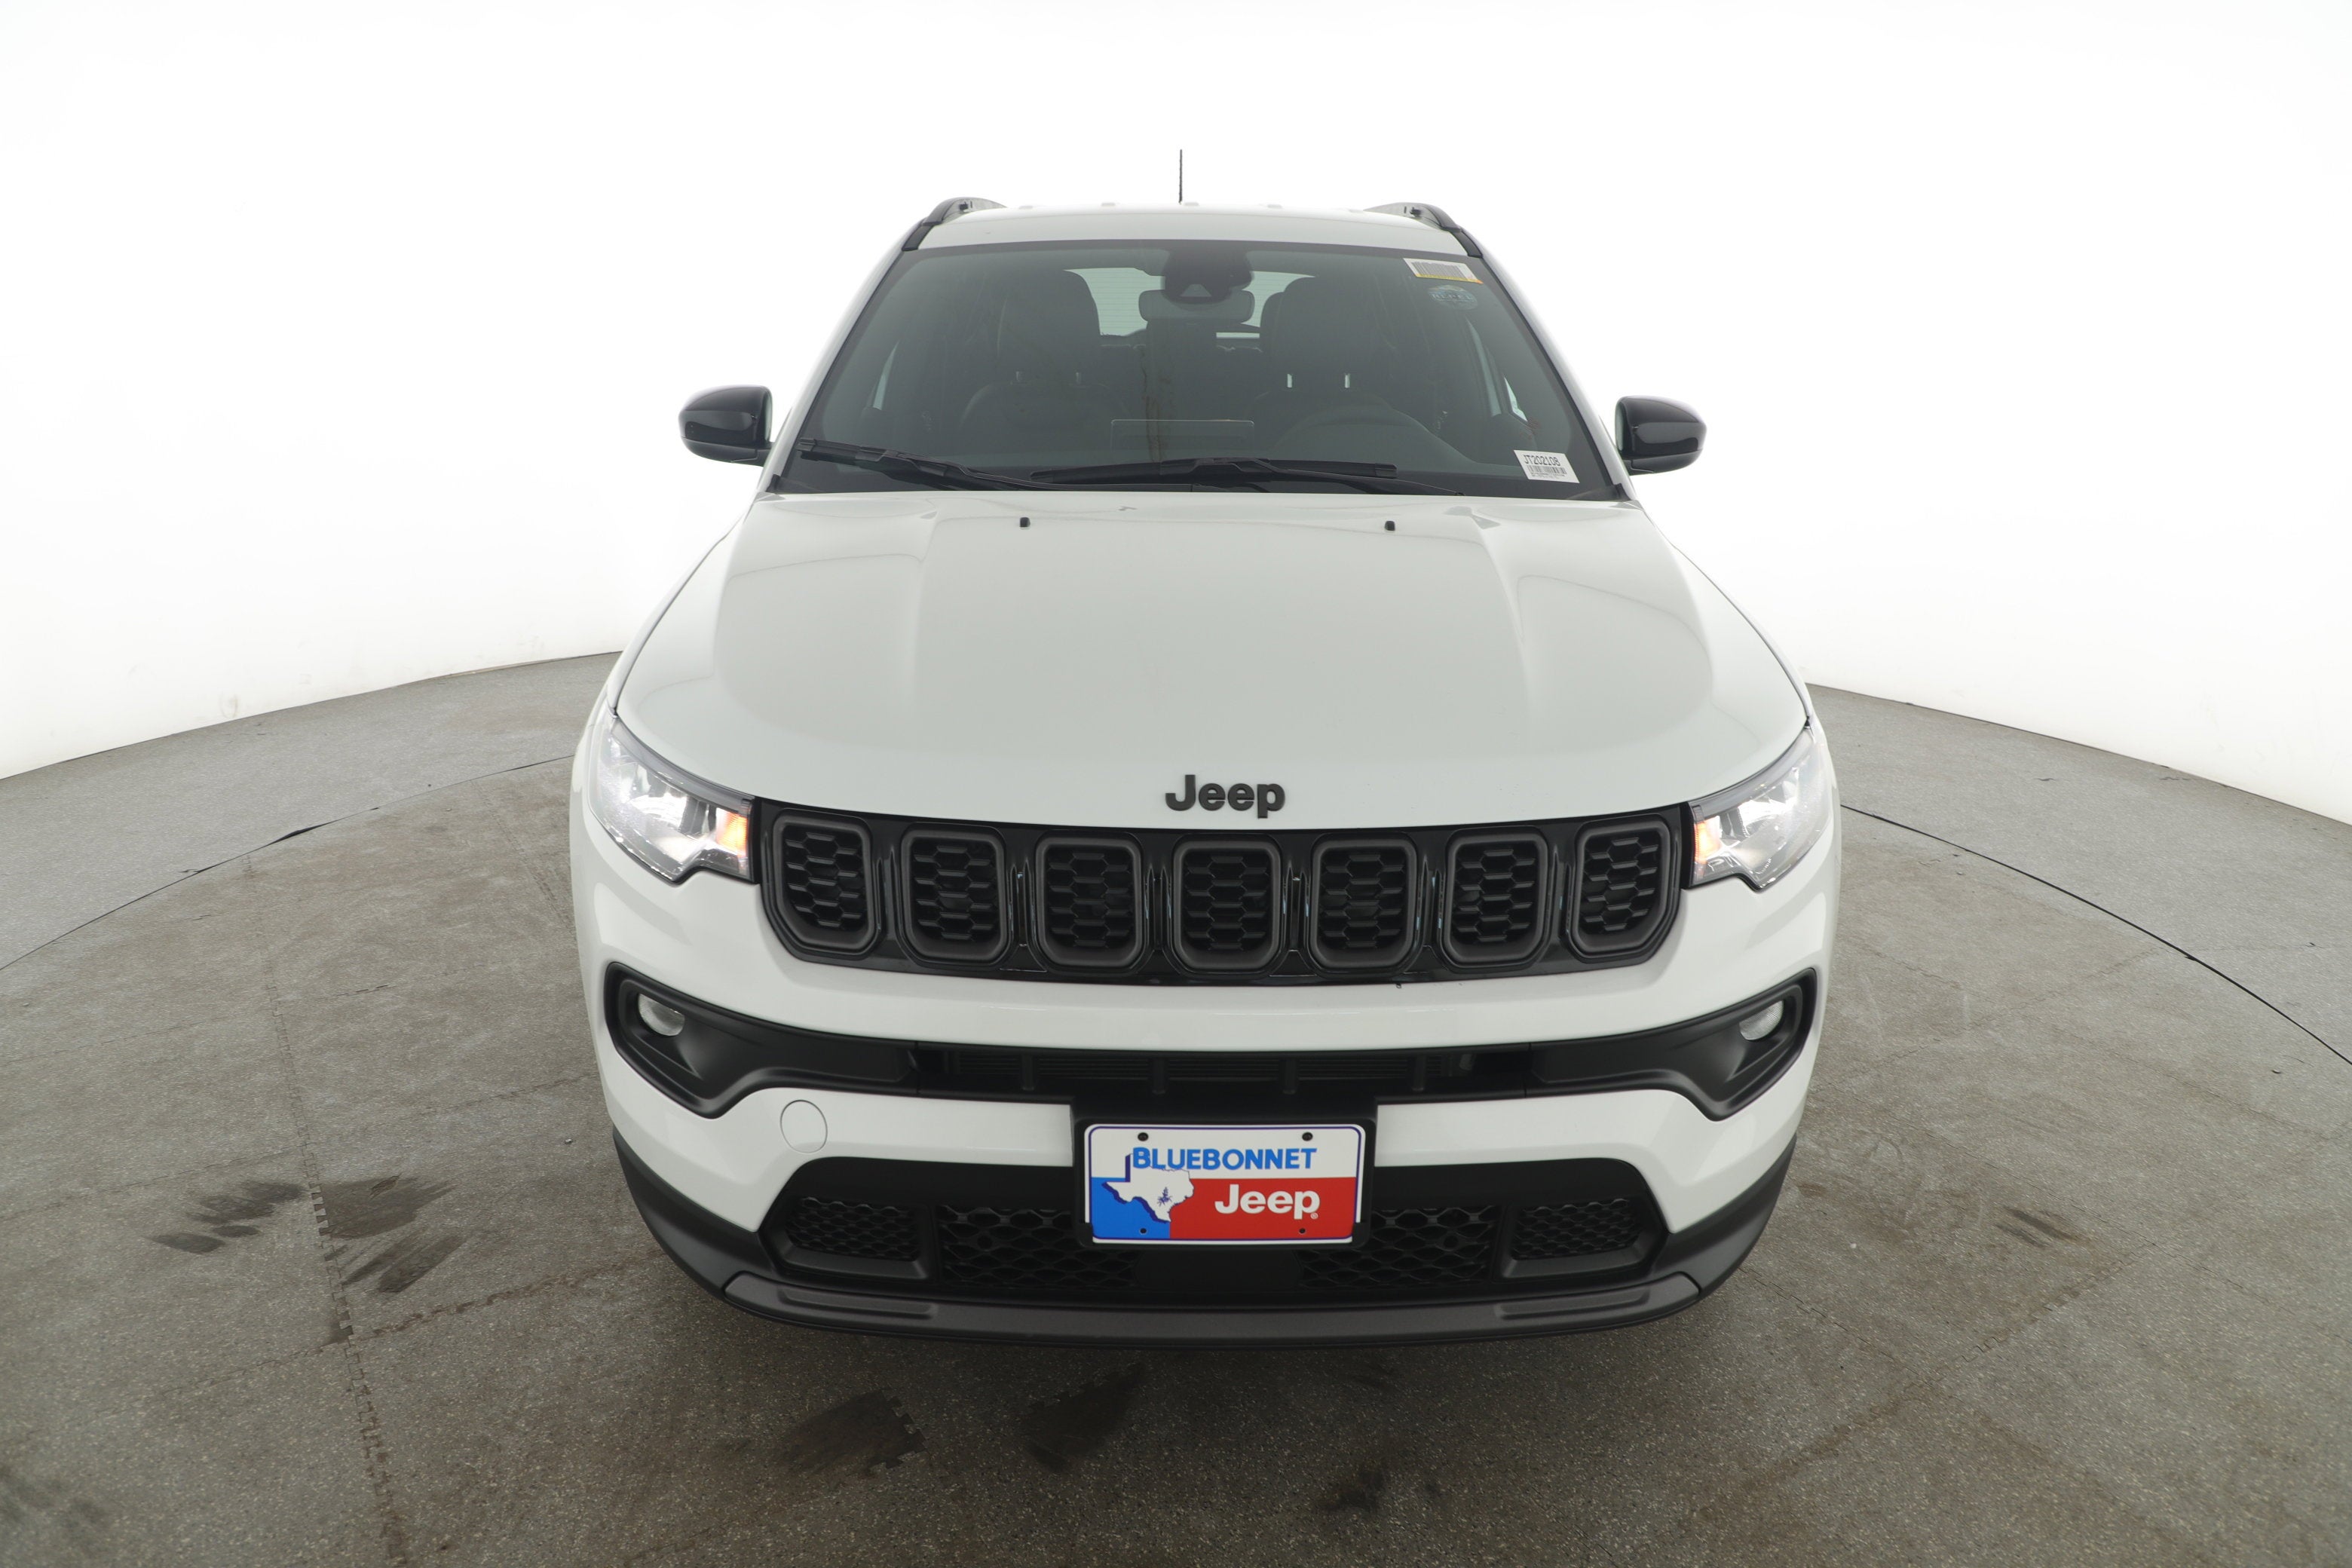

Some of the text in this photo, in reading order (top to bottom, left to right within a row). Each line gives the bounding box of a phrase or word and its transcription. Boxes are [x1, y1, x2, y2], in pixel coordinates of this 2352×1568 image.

[1524, 455, 1561, 466] JT202108
[1165, 774, 1286, 819] Jeep
[1132, 1147, 1318, 1170] BLUEBONNET
[1214, 1184, 1321, 1220] Jeep
